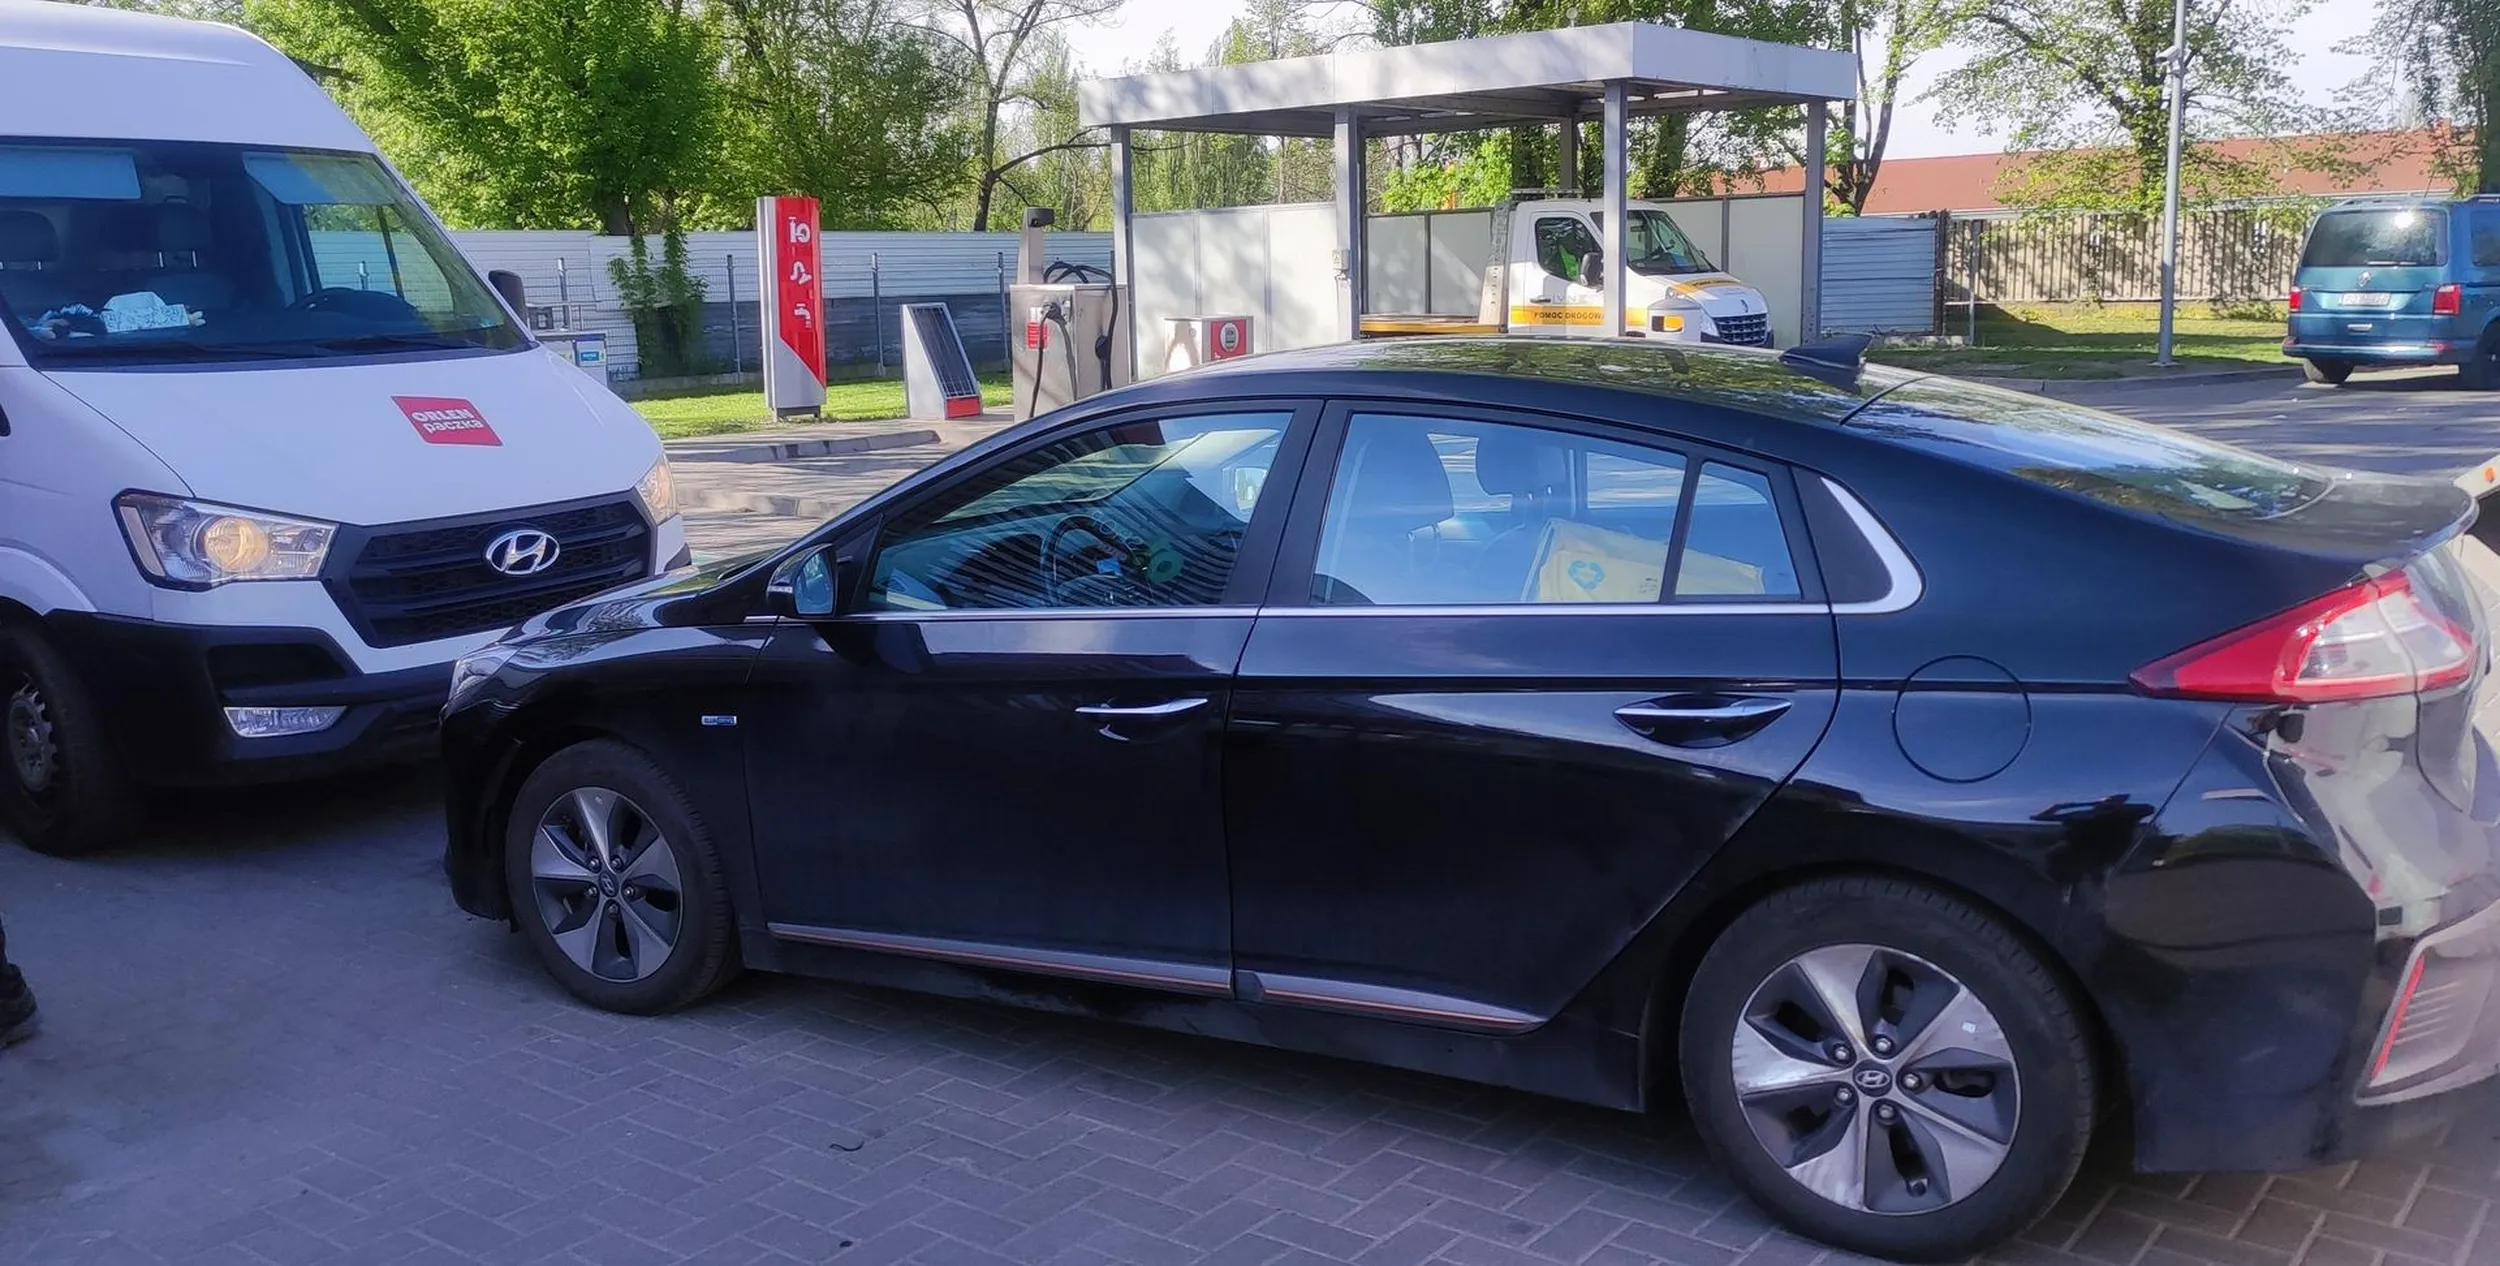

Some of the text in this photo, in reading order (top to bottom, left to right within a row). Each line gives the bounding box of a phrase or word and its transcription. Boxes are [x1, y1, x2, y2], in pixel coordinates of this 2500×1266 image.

[1565, 311, 1604, 320] DROGOW
[412, 408, 474, 422] ORLEN
[423, 419, 483, 433] paczka
